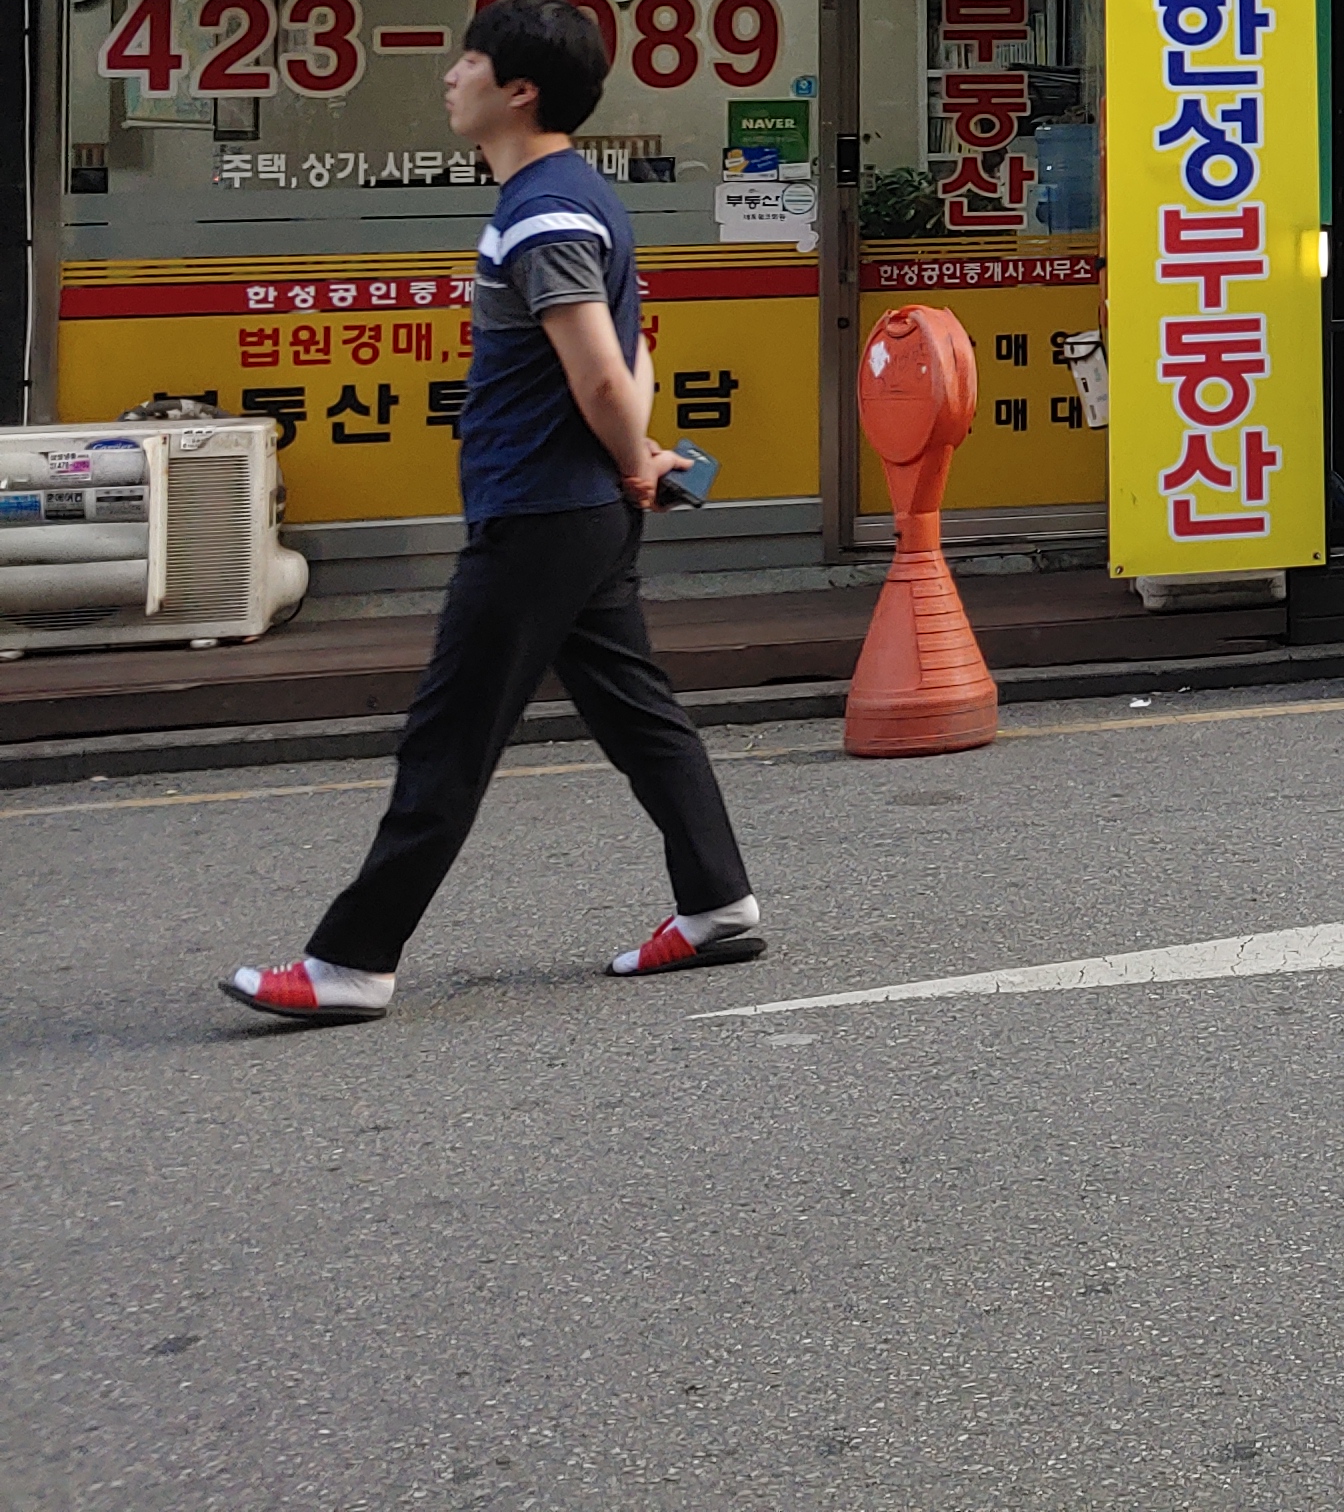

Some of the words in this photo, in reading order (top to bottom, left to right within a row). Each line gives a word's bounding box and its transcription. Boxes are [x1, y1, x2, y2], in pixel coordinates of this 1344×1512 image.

[741, 119, 796, 129] NAVER
[879, 261, 1025, 287] 한성공인중개사
[1031, 259, 1093, 282] 사무소
